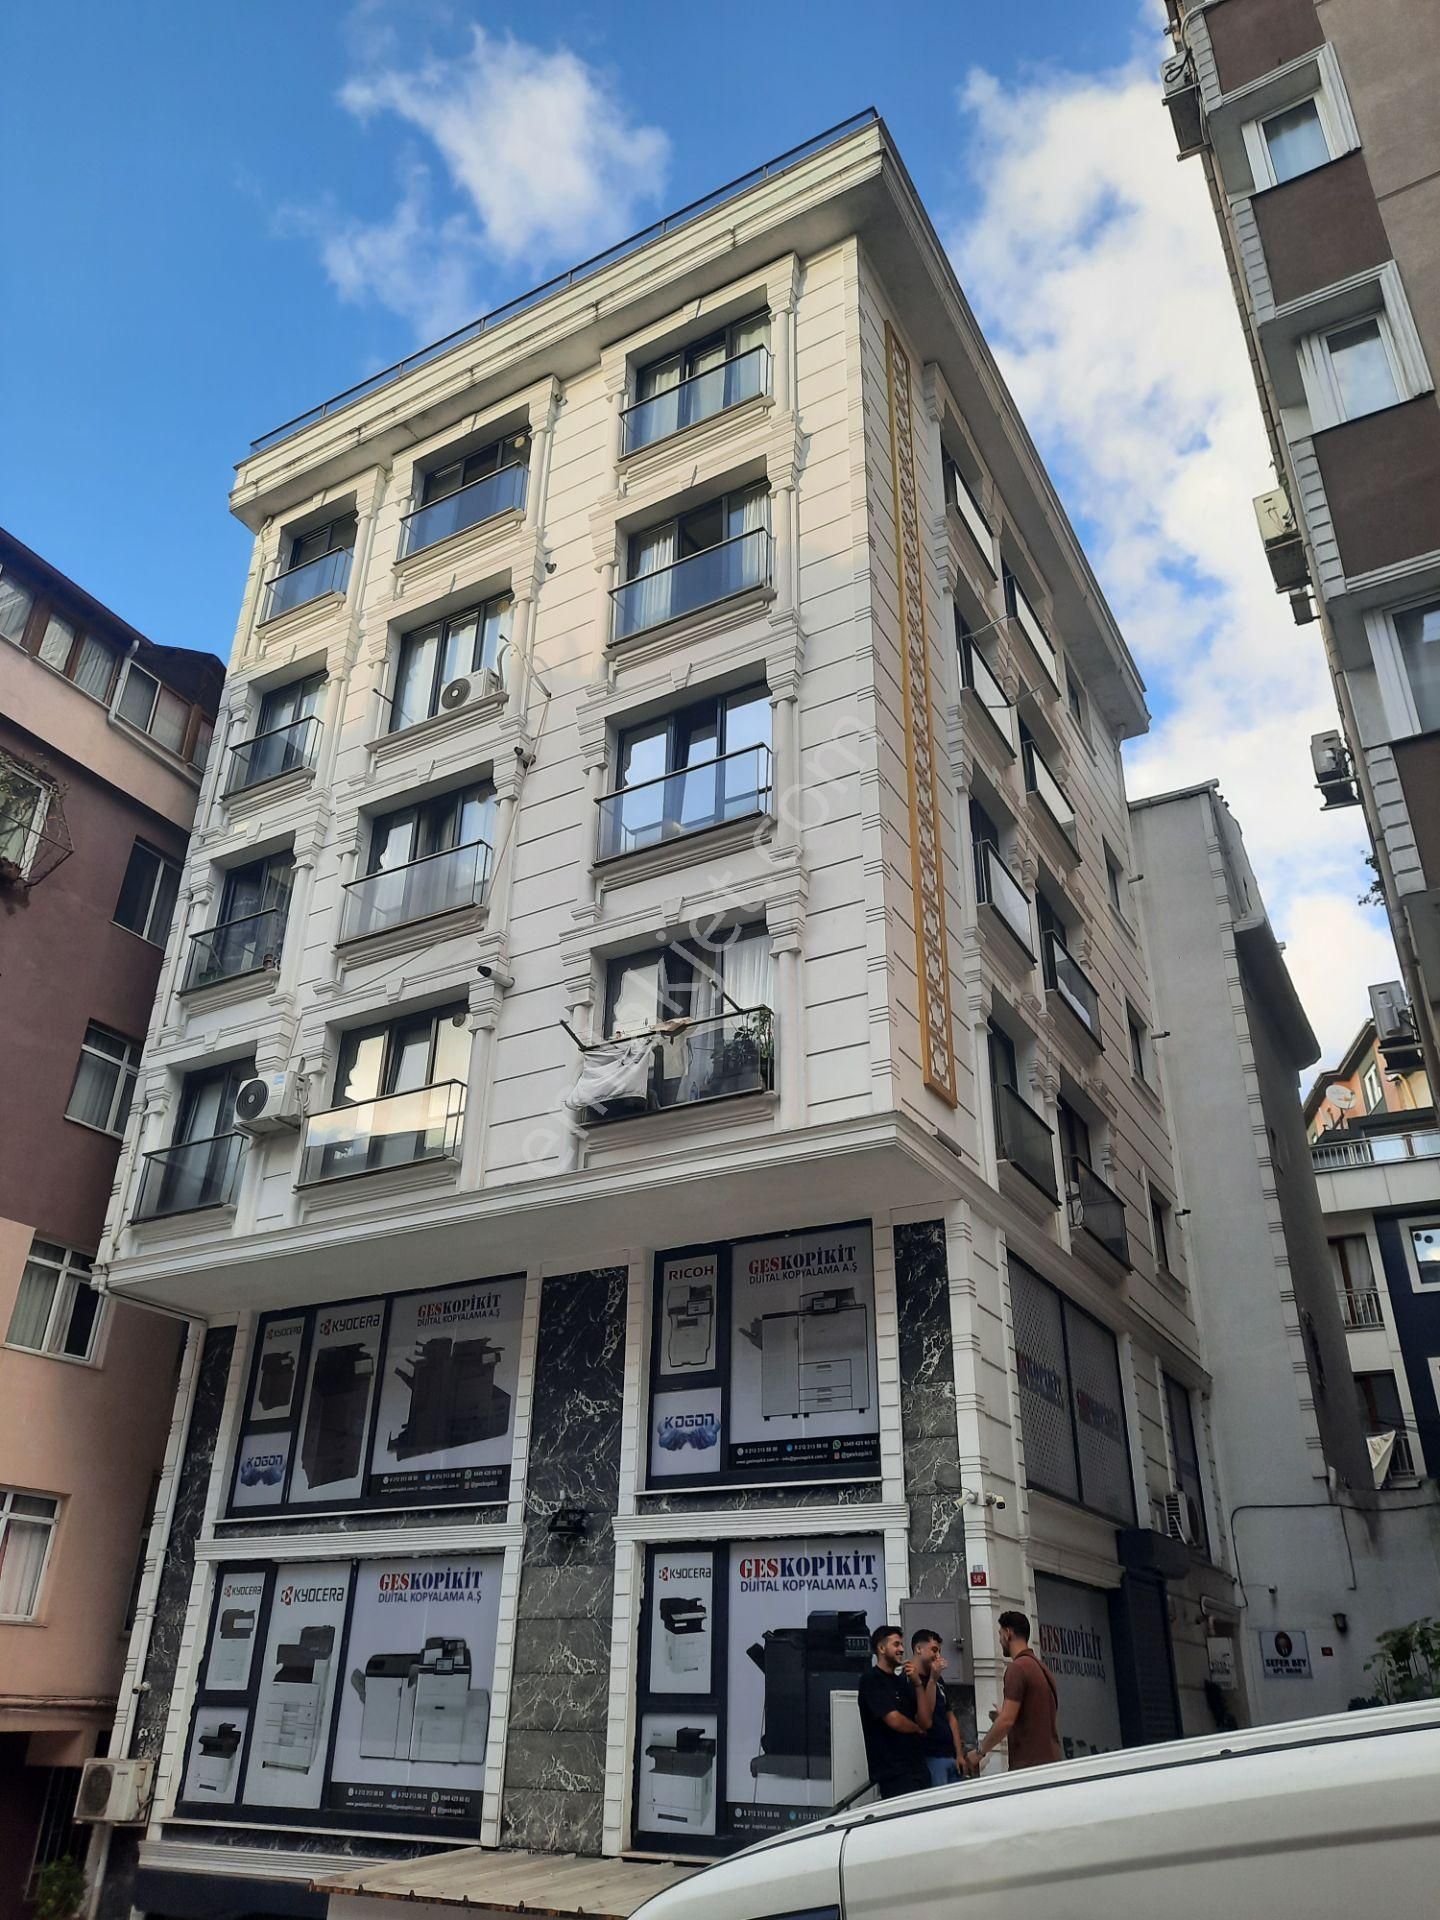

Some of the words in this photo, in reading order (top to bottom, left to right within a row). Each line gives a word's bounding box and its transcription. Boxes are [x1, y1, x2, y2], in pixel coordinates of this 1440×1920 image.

[668, 1265, 714, 1281] RICOH
[782, 1264, 840, 1280] KOPYALAMA
[332, 1313, 380, 1333] KYOCERA
[739, 1550, 876, 1579] GESKOPİKİT
[669, 1567, 711, 1579] KYOCERA
[782, 1578, 856, 1592] KOPYALAMA
[294, 1587, 345, 1603] KYOCERA
[410, 1591, 465, 1602] KOPYALAMA
